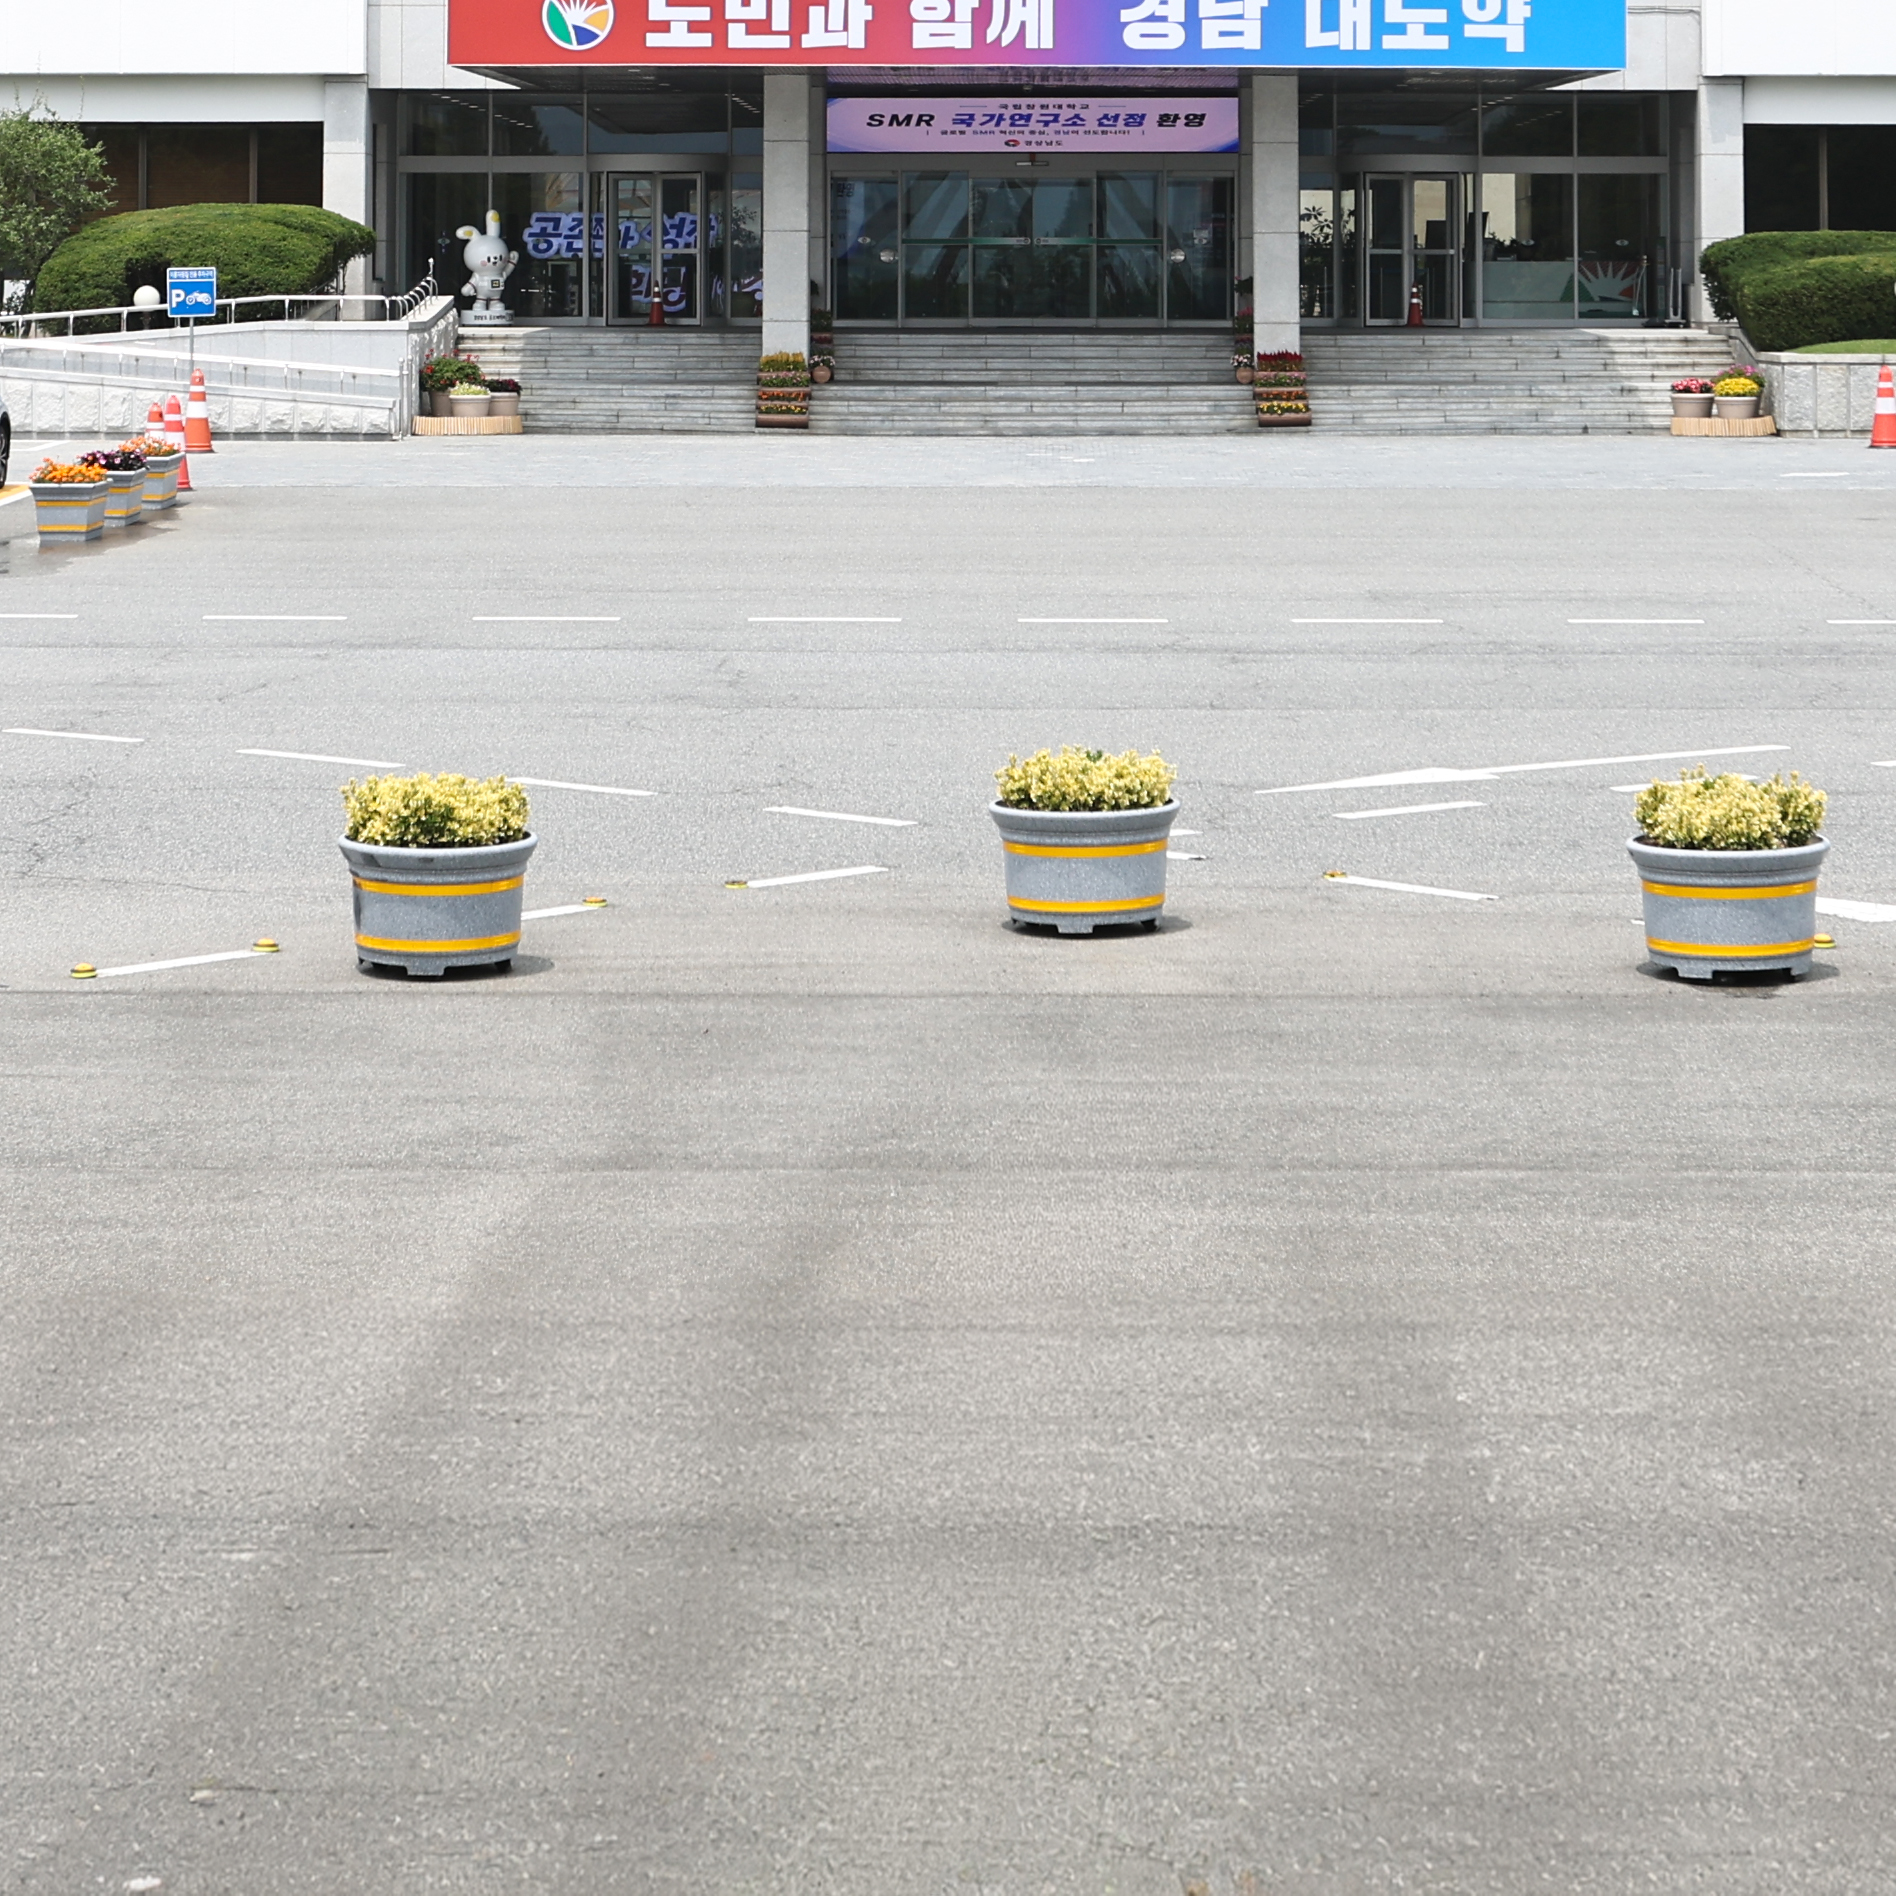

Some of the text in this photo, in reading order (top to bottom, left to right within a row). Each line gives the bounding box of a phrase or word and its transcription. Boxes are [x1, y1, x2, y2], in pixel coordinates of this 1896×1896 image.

[866, 113, 1207, 128] SMR 국가연구소 선정 환영
[1024, 139, 1063, 147] 경상남도
[171, 288, 185, 308] P
